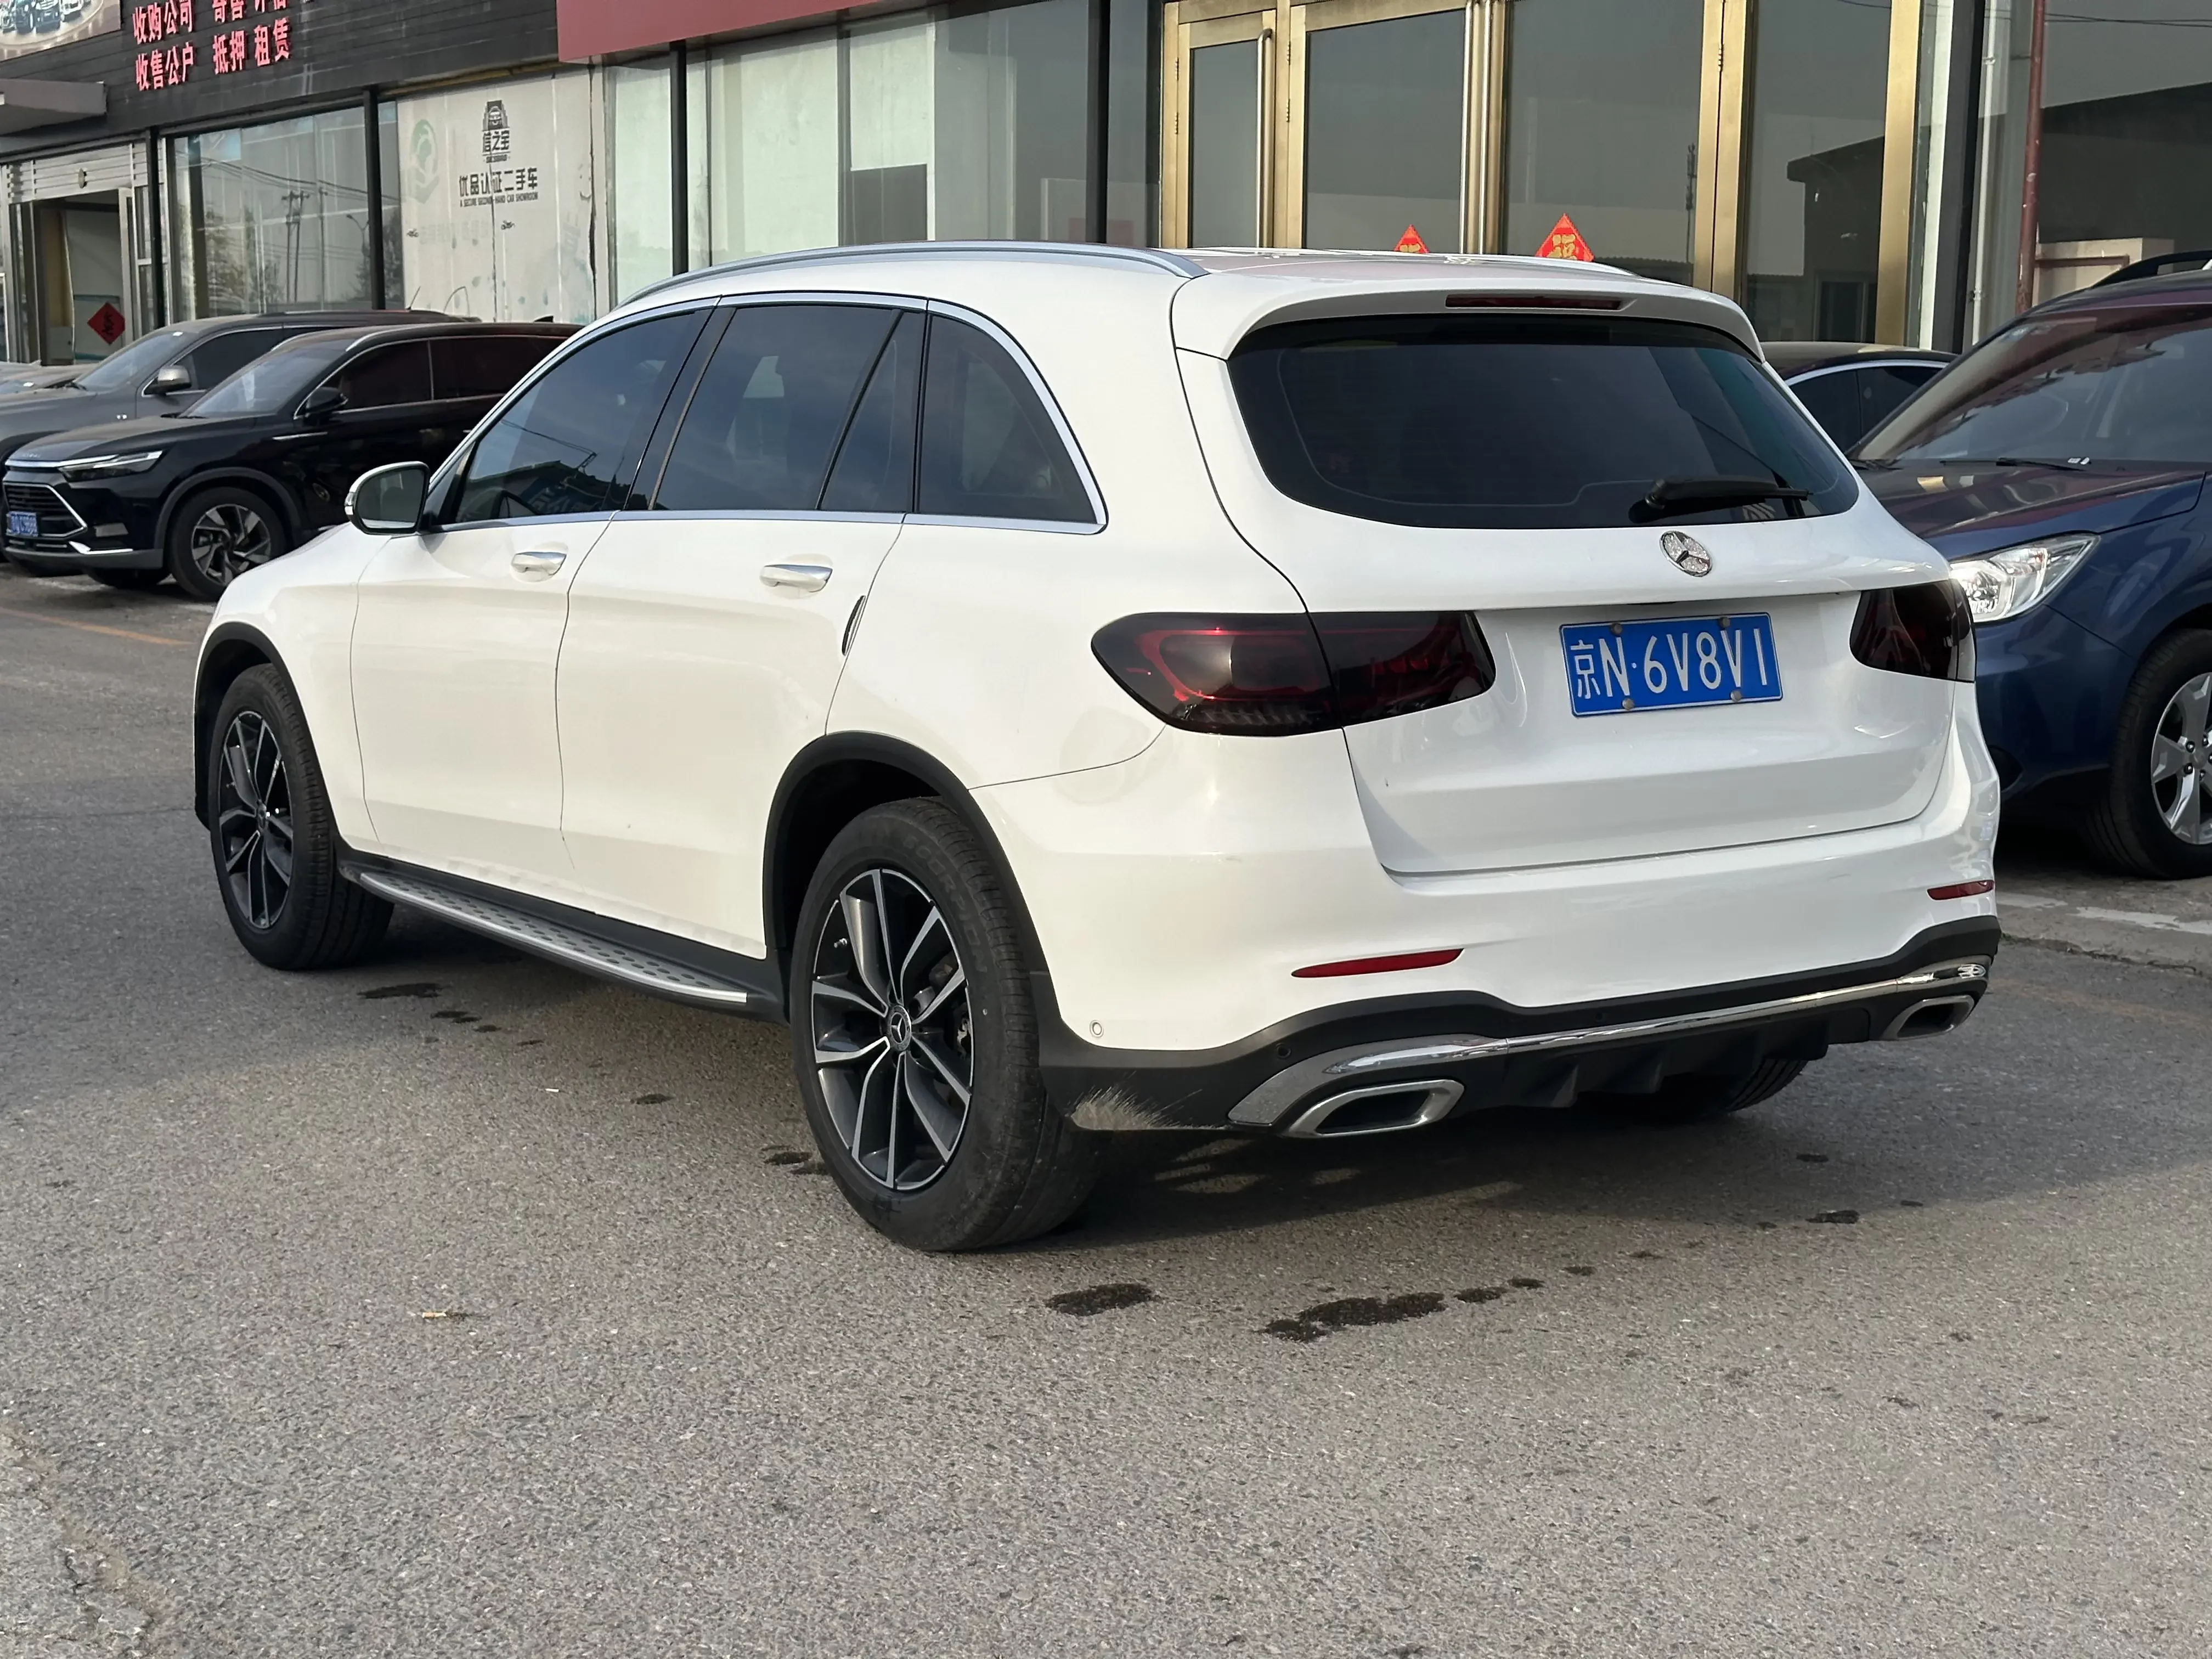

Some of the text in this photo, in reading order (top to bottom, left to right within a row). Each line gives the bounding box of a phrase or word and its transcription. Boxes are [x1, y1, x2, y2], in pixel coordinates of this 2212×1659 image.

[132, 0, 193, 44] 收购公司
[136, 18, 290, 91] 收售公户 抵押 租赁
[459, 167, 538, 197] 优品认证二手车
